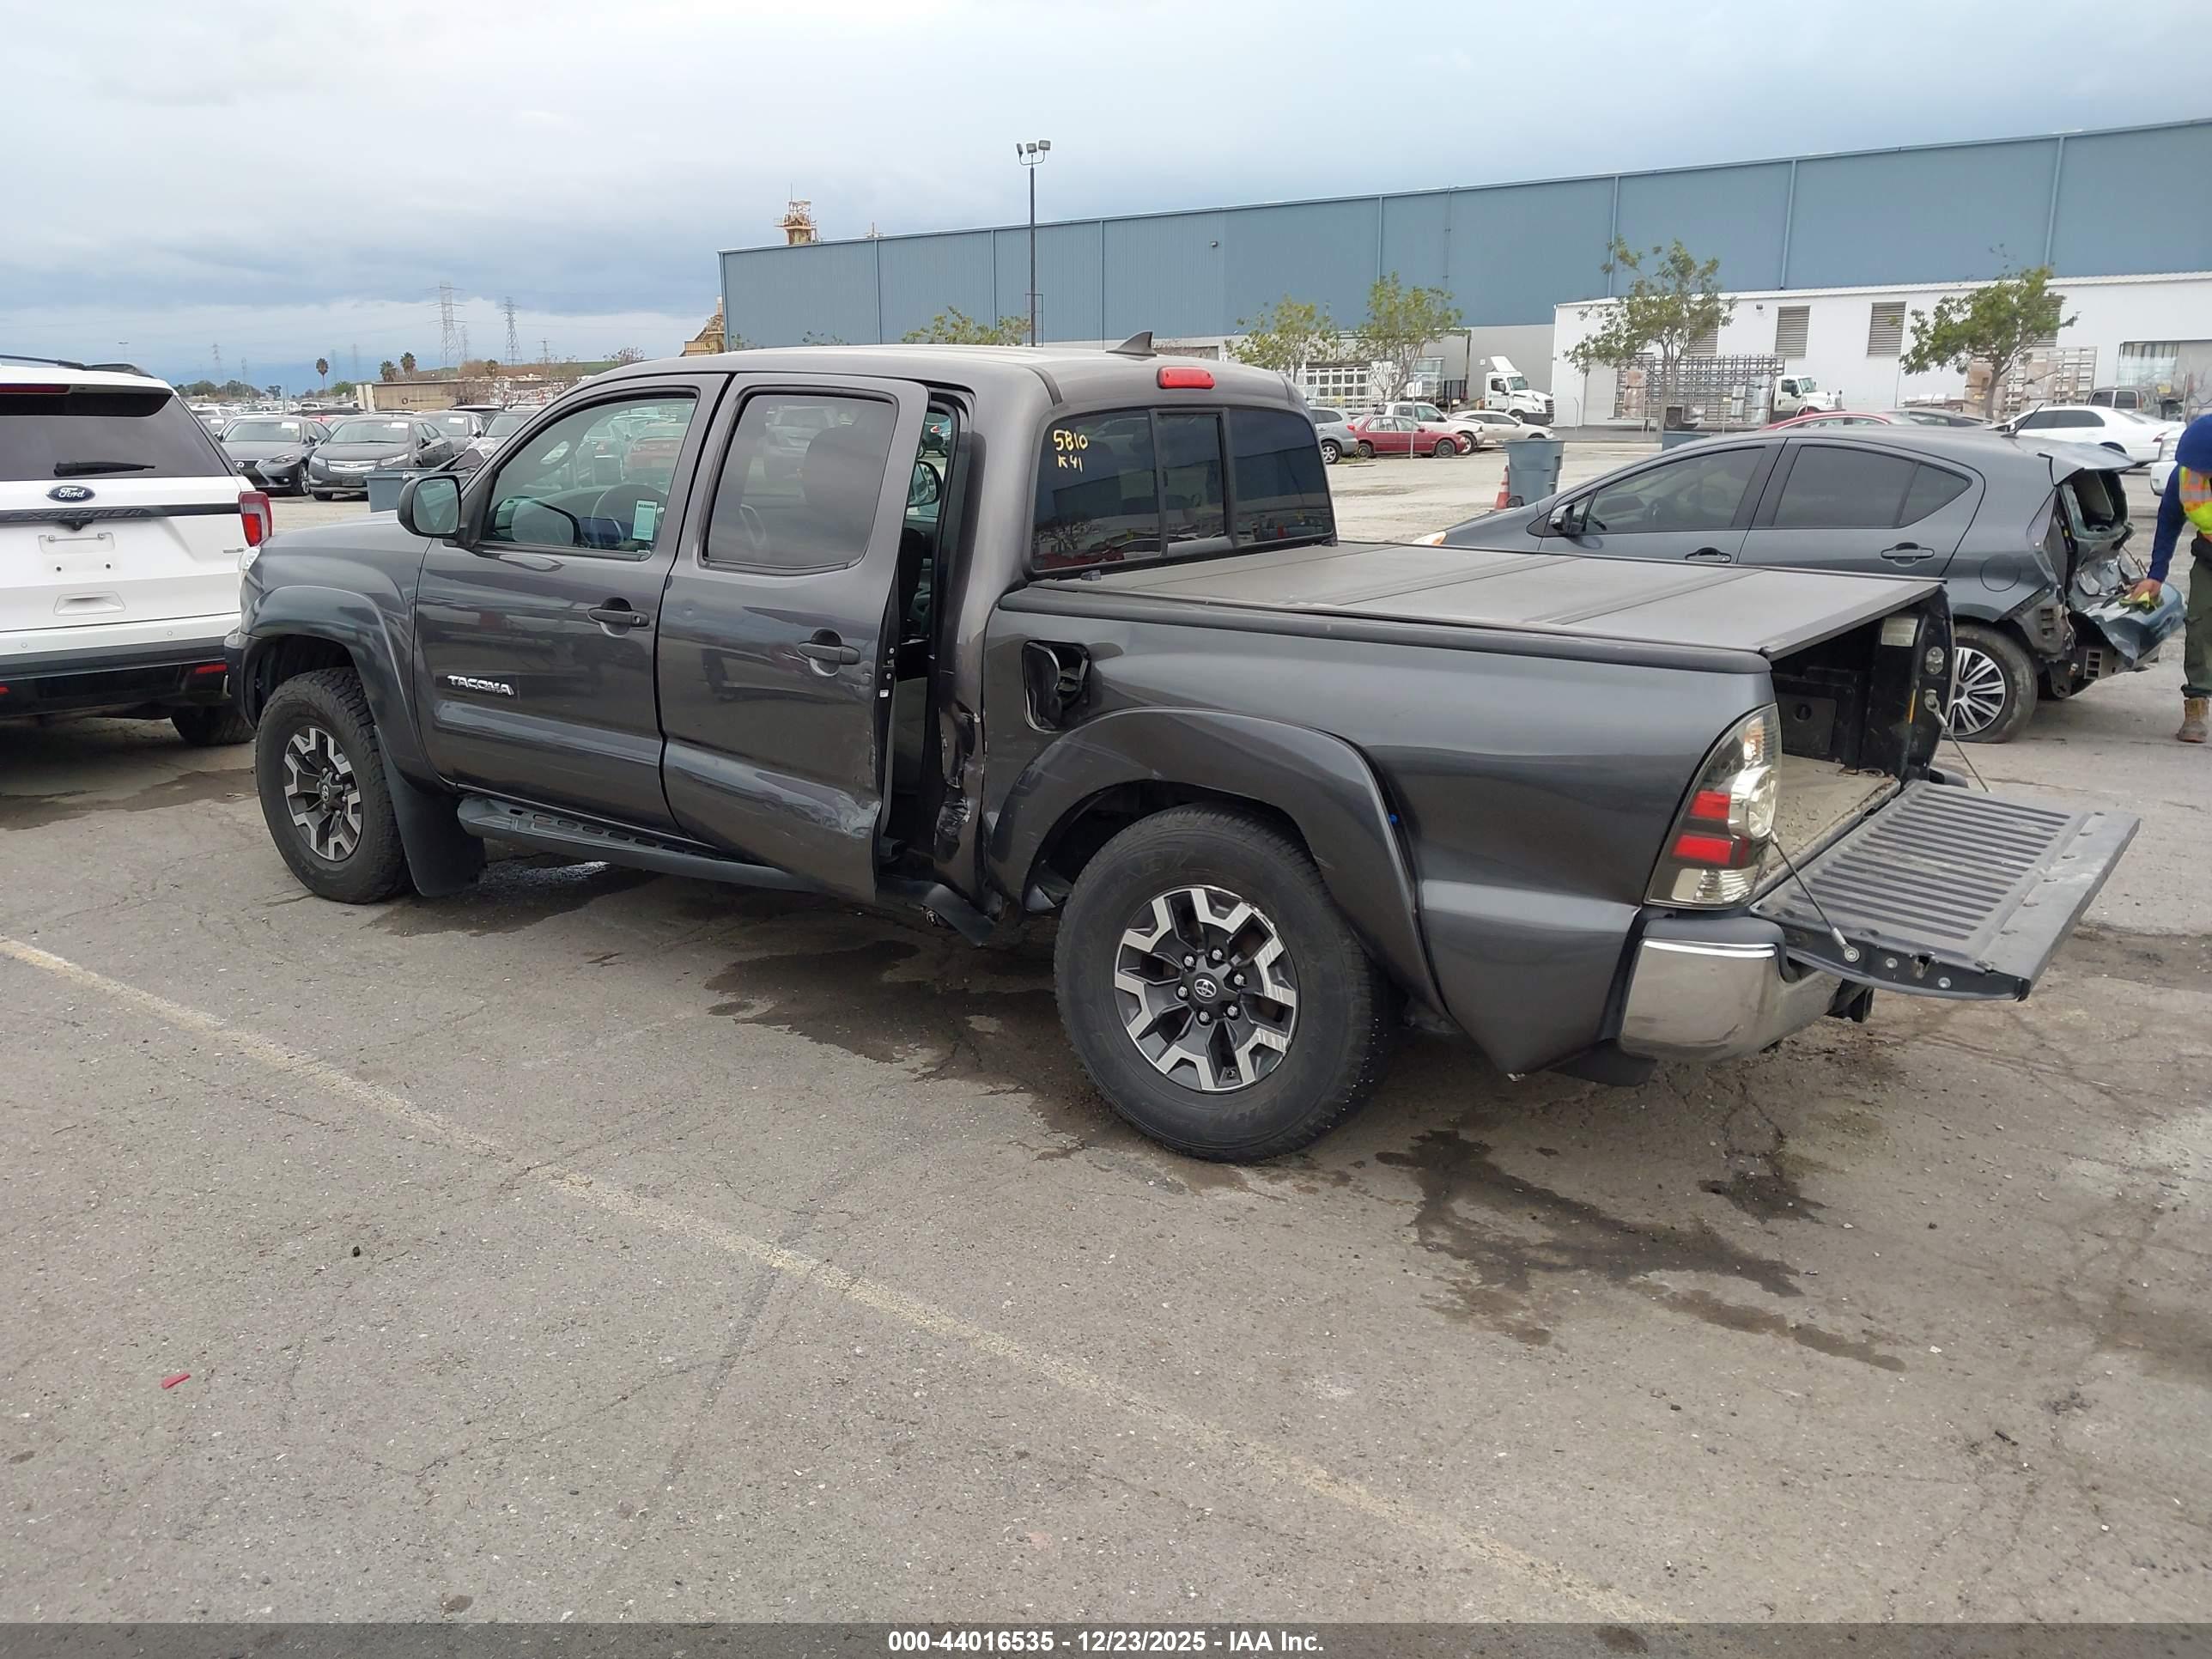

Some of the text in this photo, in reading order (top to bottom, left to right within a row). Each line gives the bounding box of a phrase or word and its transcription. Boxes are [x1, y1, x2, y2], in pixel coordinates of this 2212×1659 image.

[1053, 429, 1089, 451] 5810
[58, 487, 86, 498] Ford
[7, 507, 143, 521] EXPLORER
[447, 675, 515, 696] TACOMA
